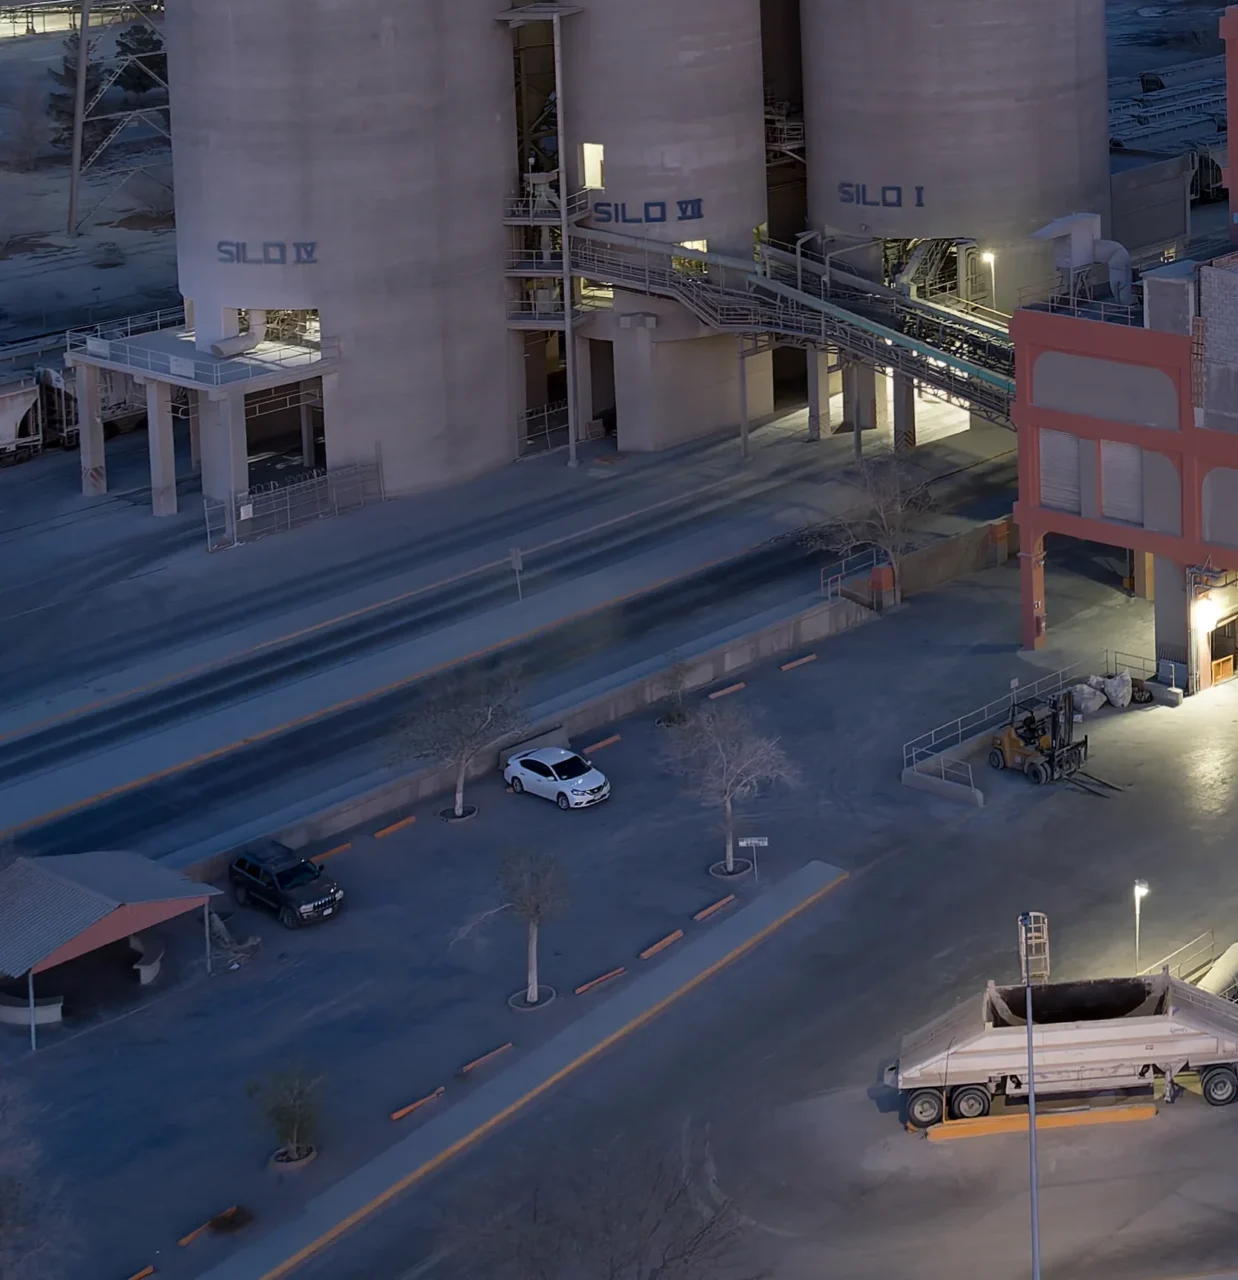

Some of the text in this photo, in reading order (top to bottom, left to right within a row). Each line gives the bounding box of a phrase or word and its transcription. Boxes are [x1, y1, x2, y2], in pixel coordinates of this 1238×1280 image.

[838, 182, 925, 208] SILO I
[593, 202, 667, 223] SILO
[217, 241, 318, 265] SILO IV
